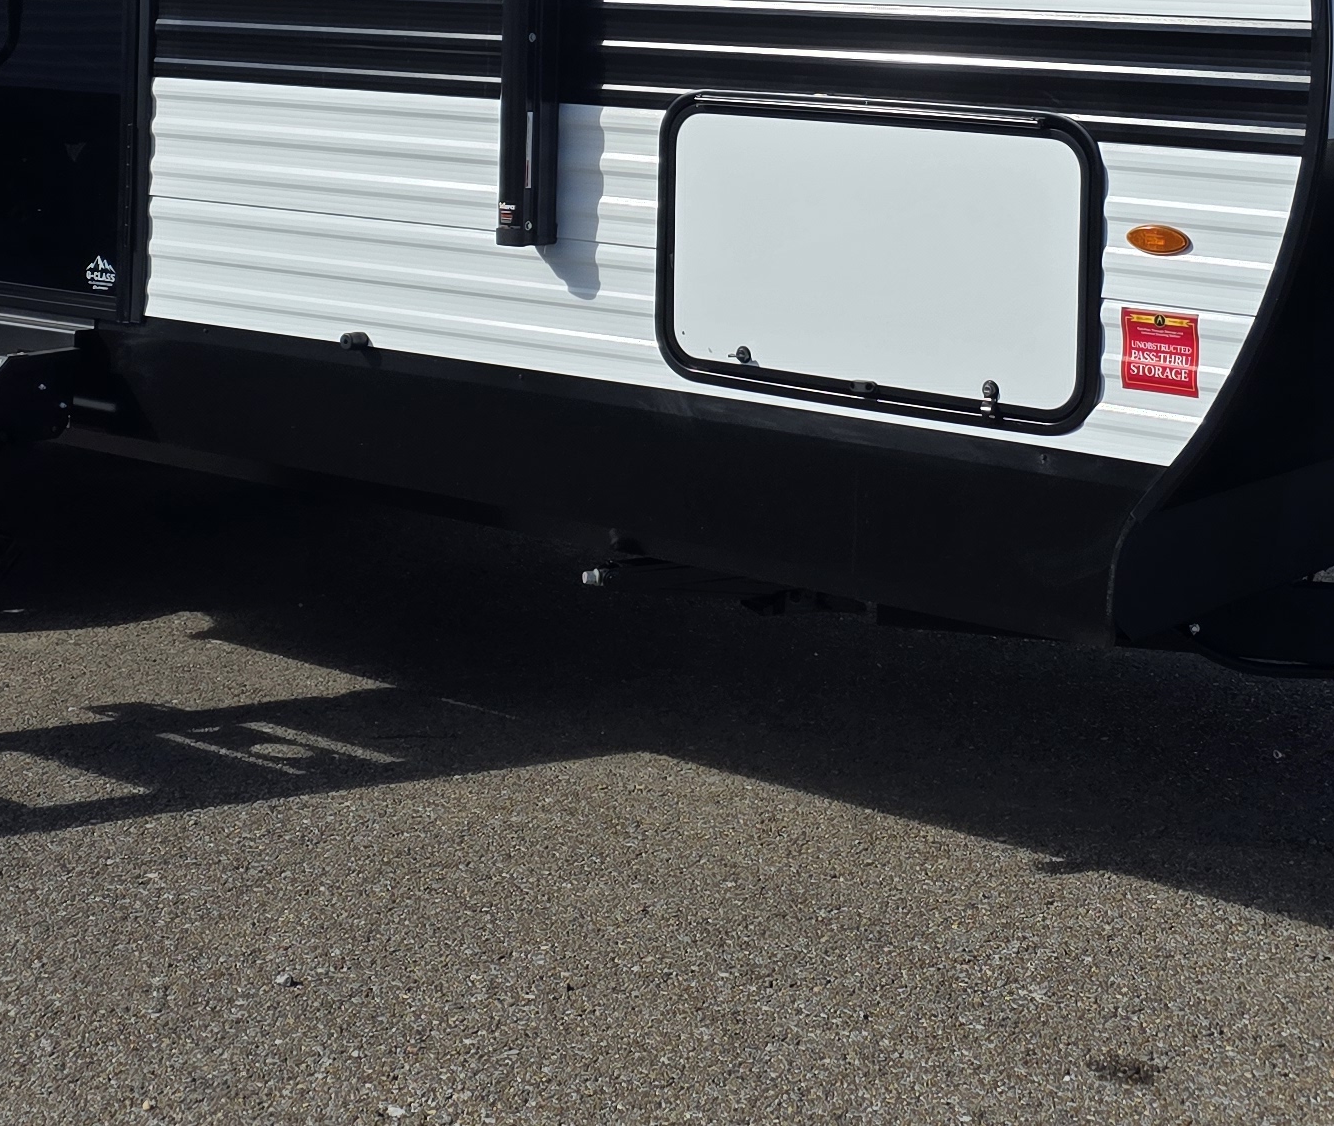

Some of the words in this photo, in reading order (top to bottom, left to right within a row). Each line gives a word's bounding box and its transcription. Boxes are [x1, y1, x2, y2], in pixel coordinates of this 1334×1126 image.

[1131, 339, 1192, 354] UNOBSTRUCTED
[1130, 349, 1191, 368] PASS-THRU
[1129, 363, 1189, 382] STORAGE
